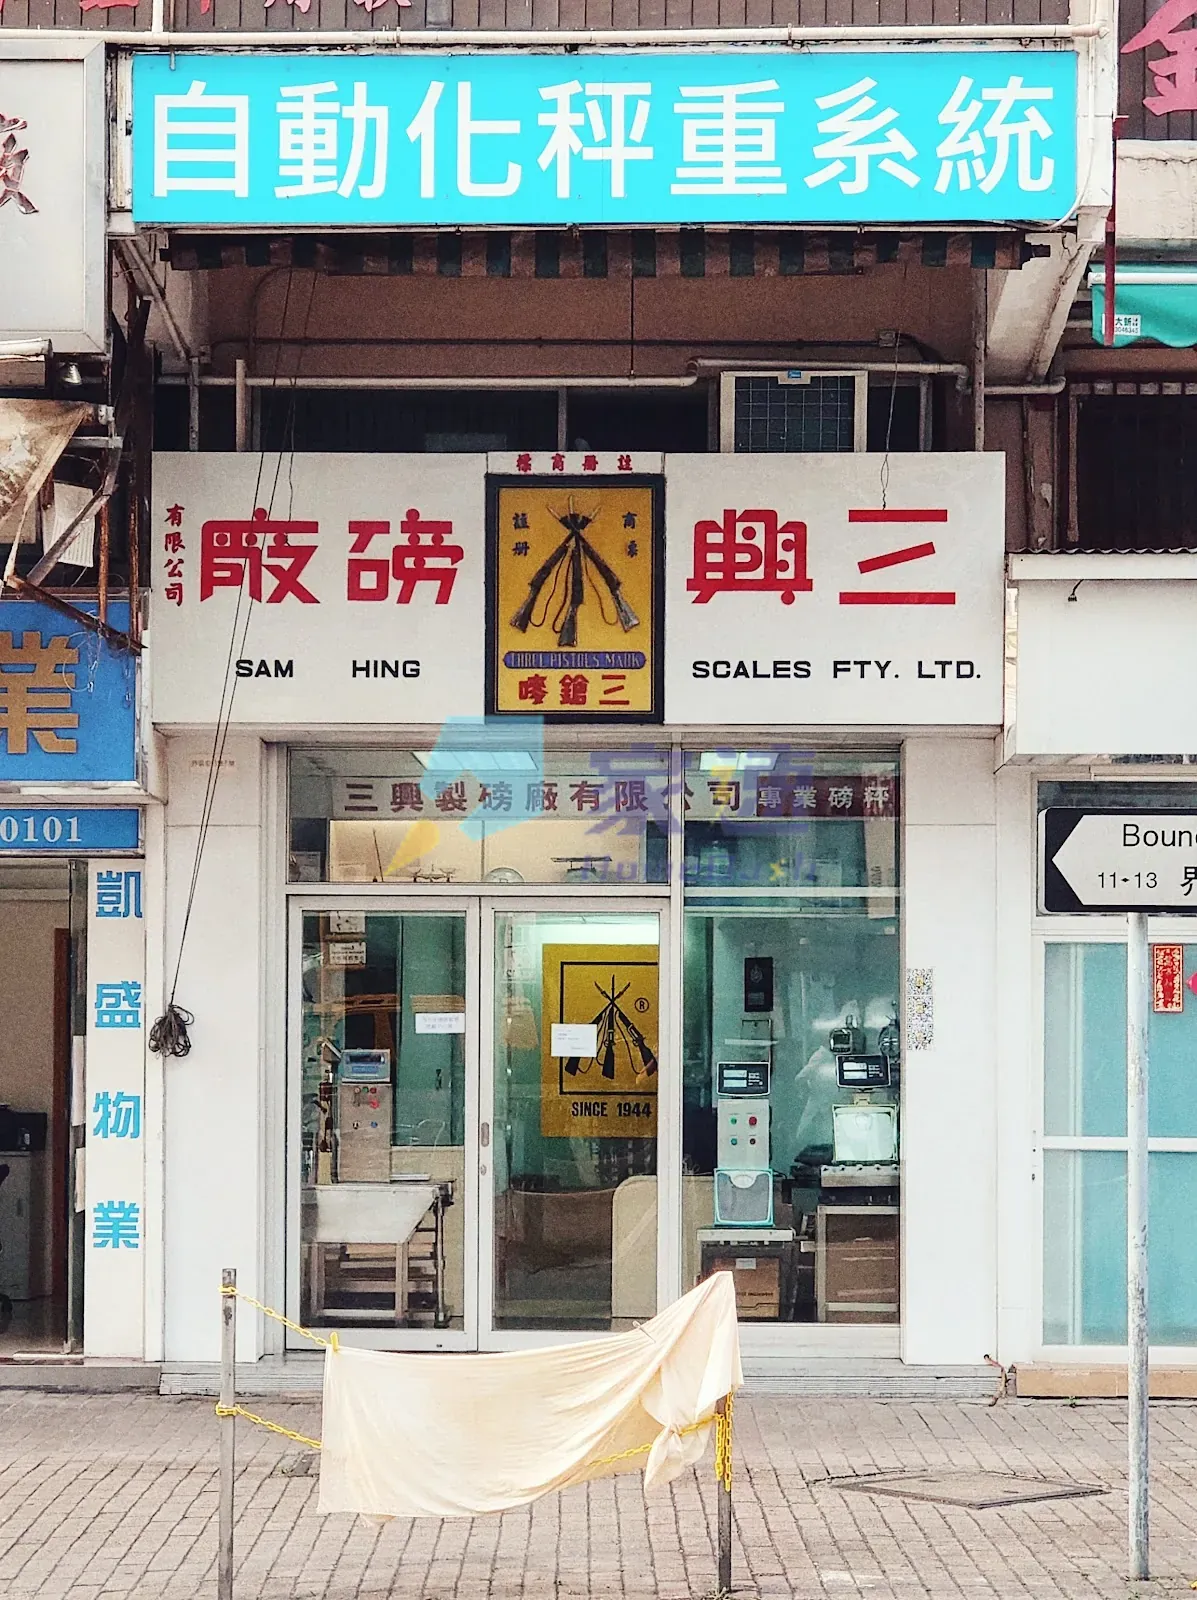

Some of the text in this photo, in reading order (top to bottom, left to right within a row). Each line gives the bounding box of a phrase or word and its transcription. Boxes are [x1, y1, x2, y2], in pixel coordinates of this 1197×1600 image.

[153, 76, 1055, 199] 自動化秤重系統
[163, 504, 186, 607] 有限公司
[235, 659, 981, 679] SAM HING SCALES FTY. LTD.
[0, 815, 82, 842] 0101
[1123, 823, 1197, 847] Boun
[93, 870, 143, 1249] 凱盛物業
[571, 1101, 652, 1118] SINCE 1944
